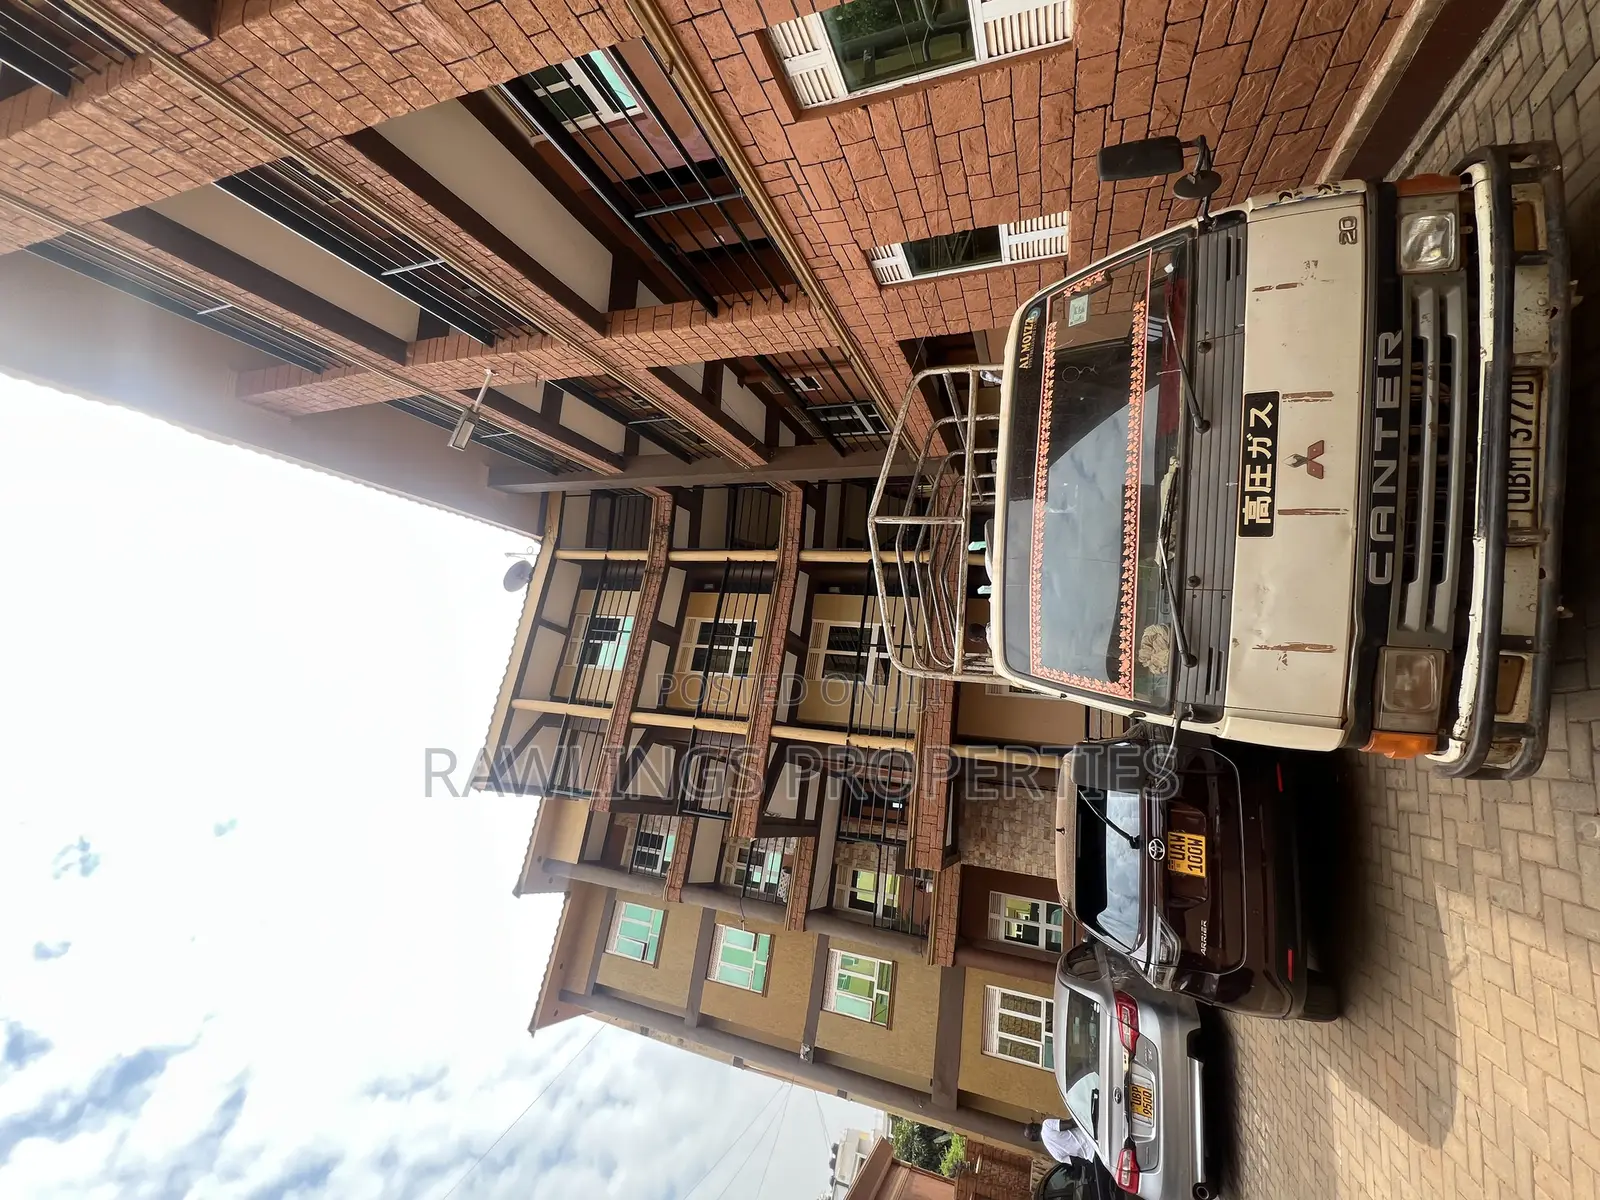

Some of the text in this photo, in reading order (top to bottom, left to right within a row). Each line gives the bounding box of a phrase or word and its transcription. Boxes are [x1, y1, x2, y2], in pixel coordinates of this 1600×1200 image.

[1338, 215, 1357, 244] 20
[1018, 353, 1030, 368] AL
[1242, 401, 1274, 524] 高圧ガス
[1368, 329, 1403, 584] CANTER
[1508, 457, 1532, 502] UBM
